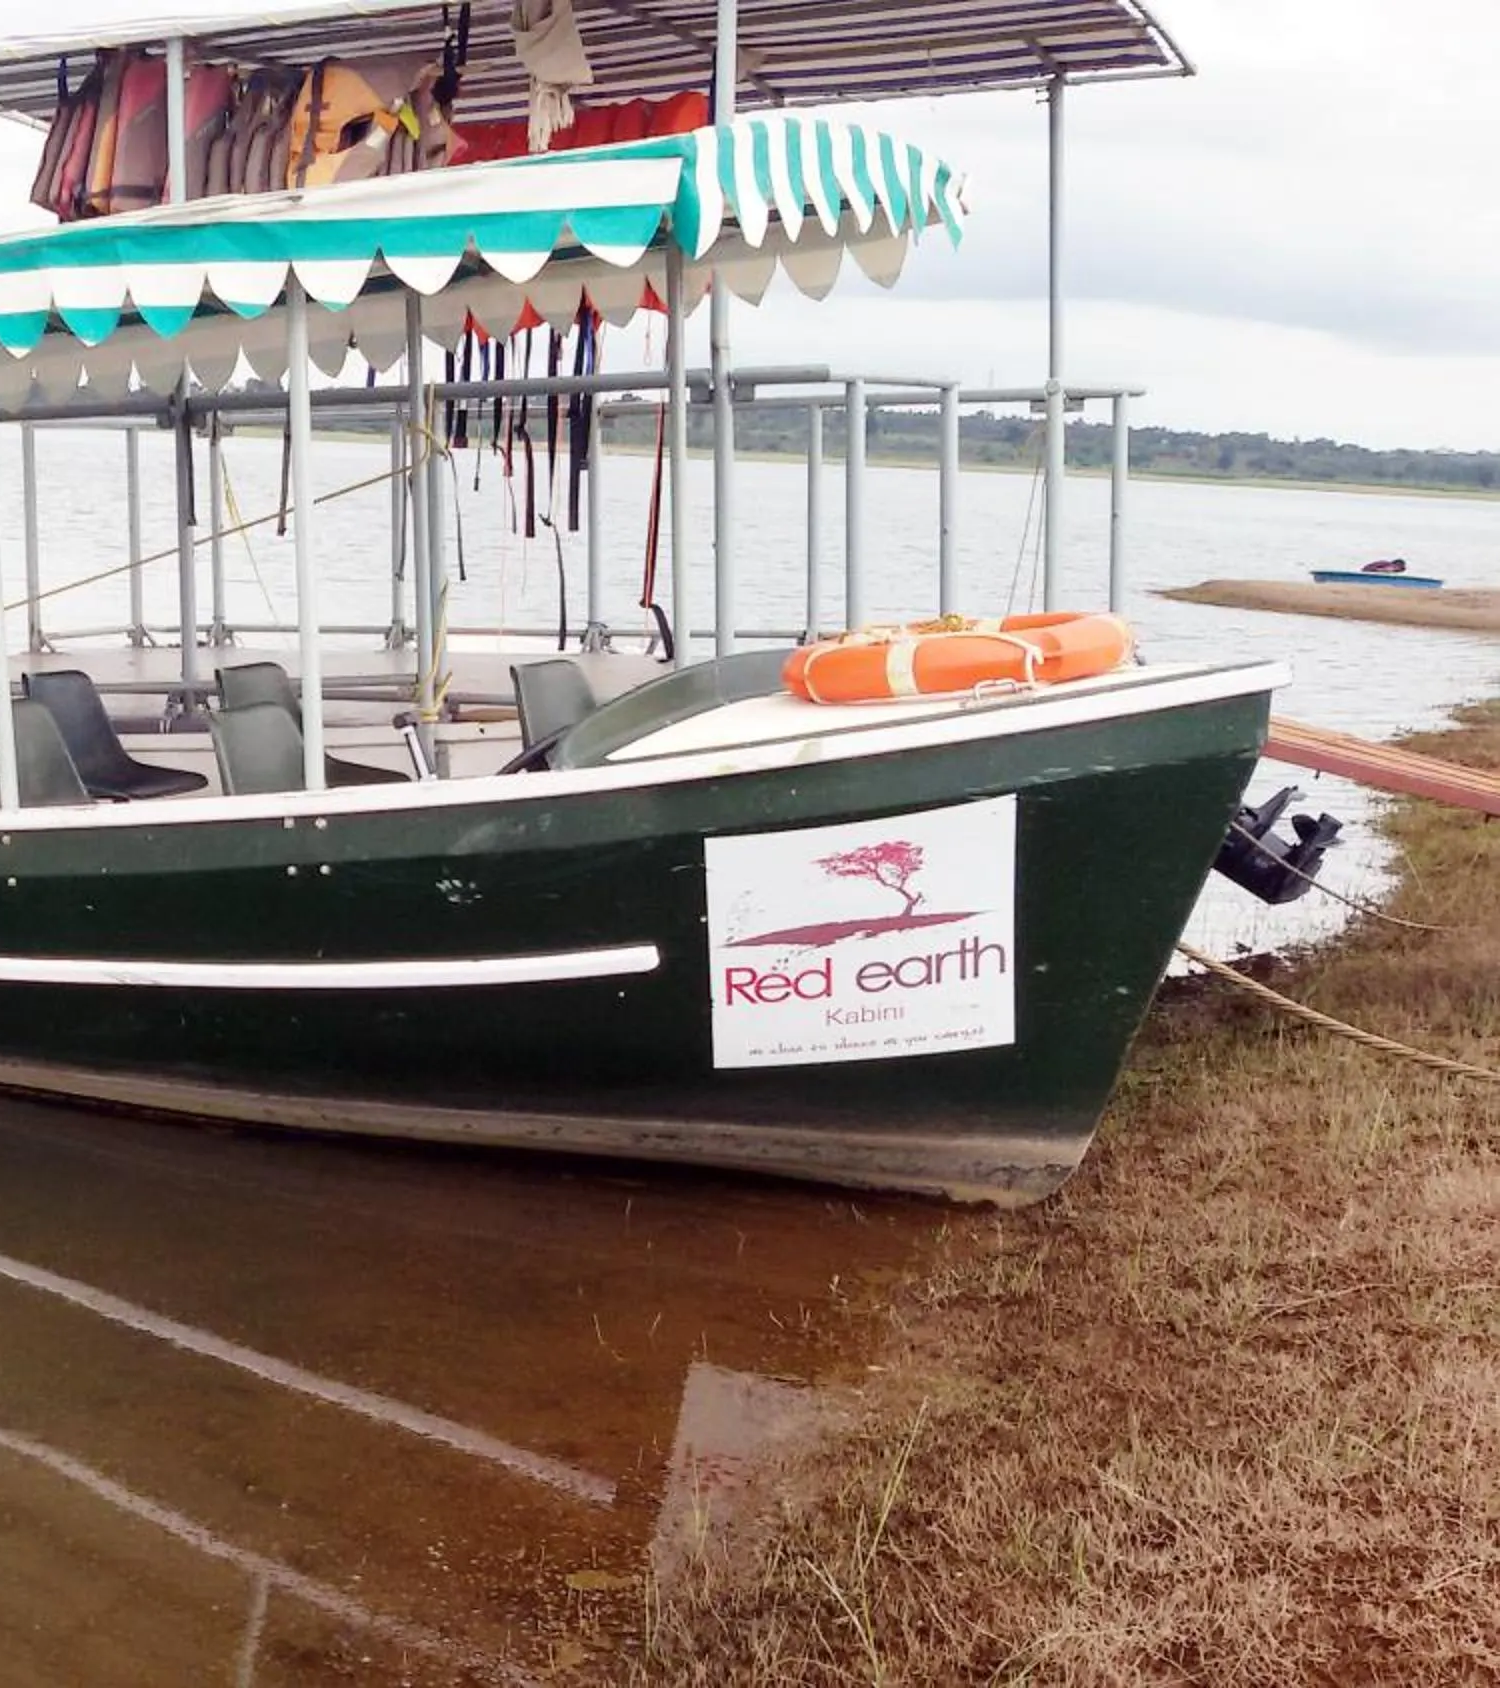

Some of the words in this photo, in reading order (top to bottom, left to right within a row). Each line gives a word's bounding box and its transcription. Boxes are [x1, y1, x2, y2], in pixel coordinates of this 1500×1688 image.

[725, 957, 833, 1006] Red
[856, 935, 1006, 993] earth
[825, 1006, 905, 1027] Kabini
